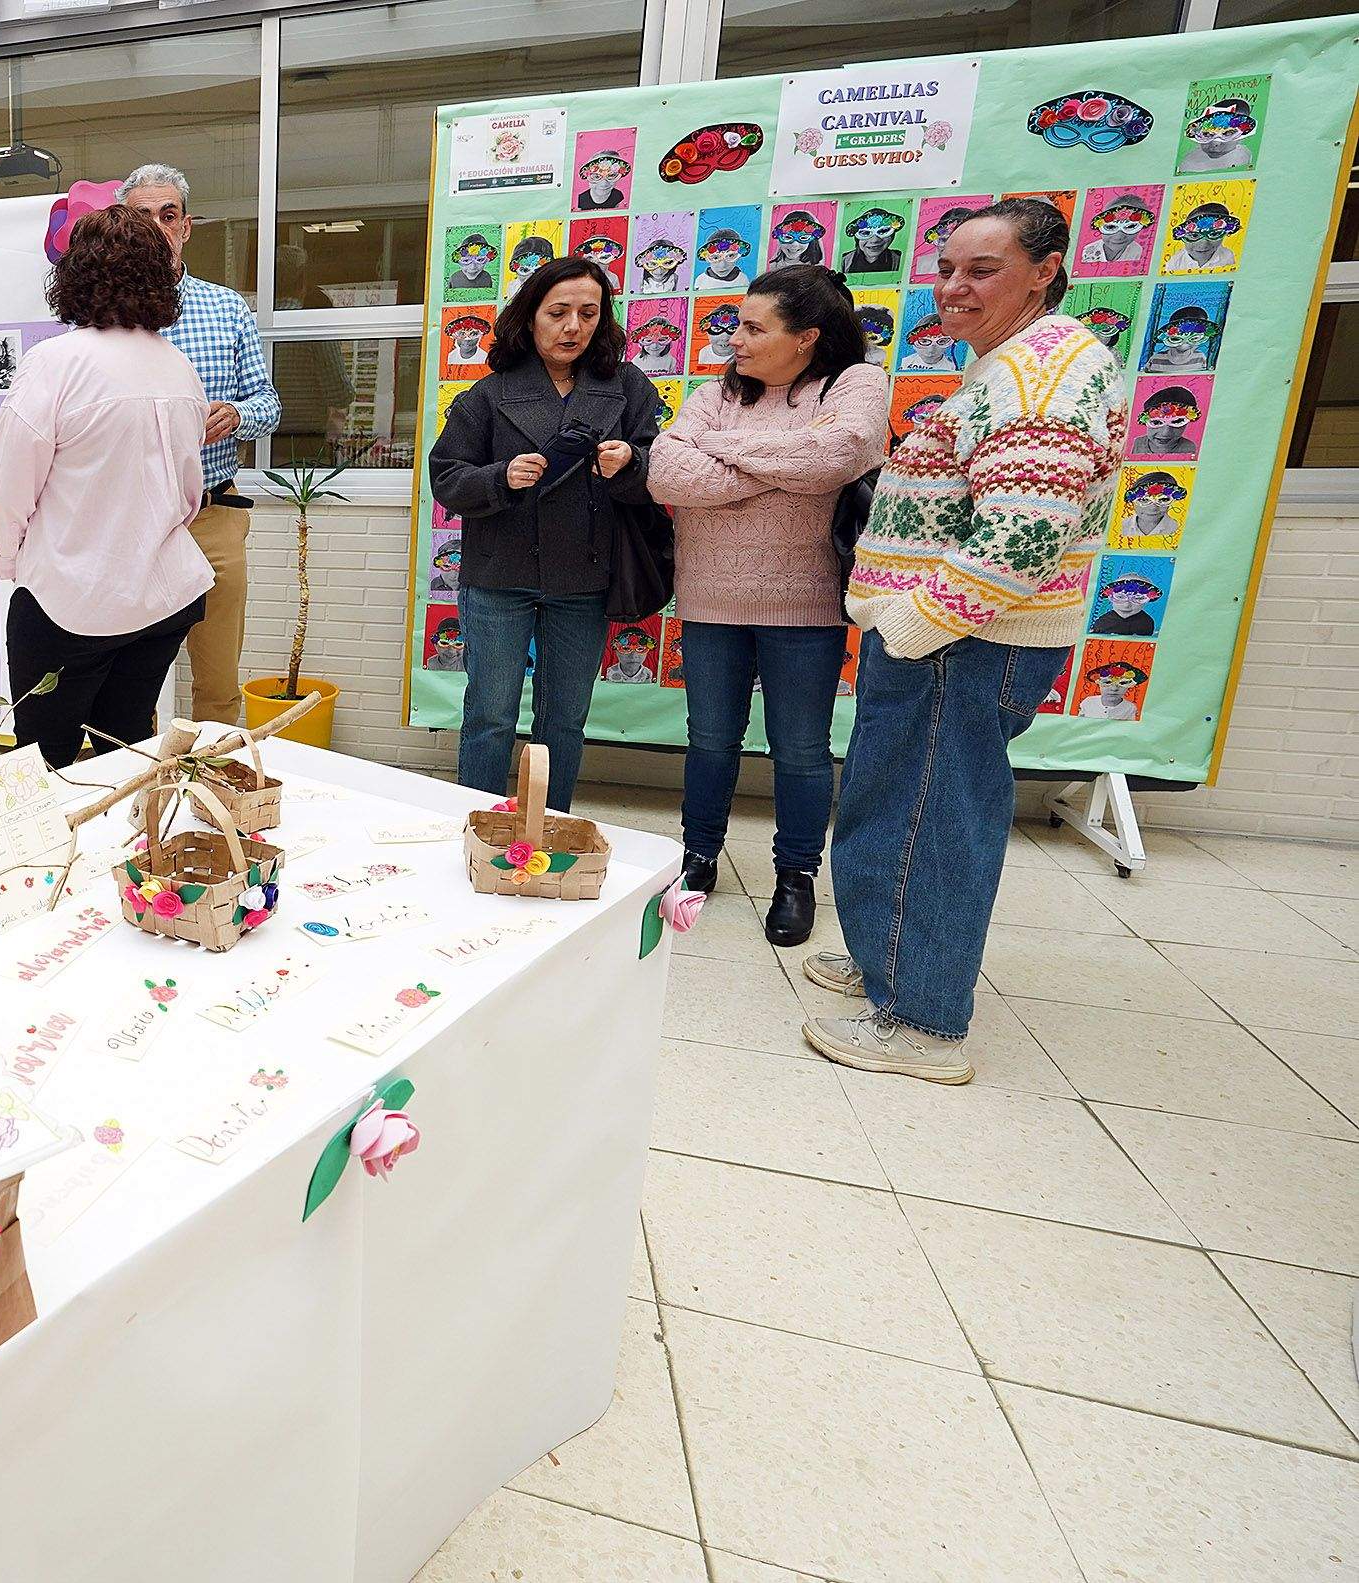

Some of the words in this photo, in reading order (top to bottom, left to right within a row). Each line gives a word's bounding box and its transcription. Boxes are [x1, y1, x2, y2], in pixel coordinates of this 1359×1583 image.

[818, 80, 939, 105] CAMELLIAS
[491, 120, 526, 130] CAMELIA
[821, 109, 927, 131] CARNIVAL
[850, 133, 905, 146] GRADERS
[813, 153, 867, 169] GUESS
[871, 150, 923, 166] WHO?
[467, 166, 513, 178] EDUCACIÓN
[515, 164, 554, 175] PRIMARIA
